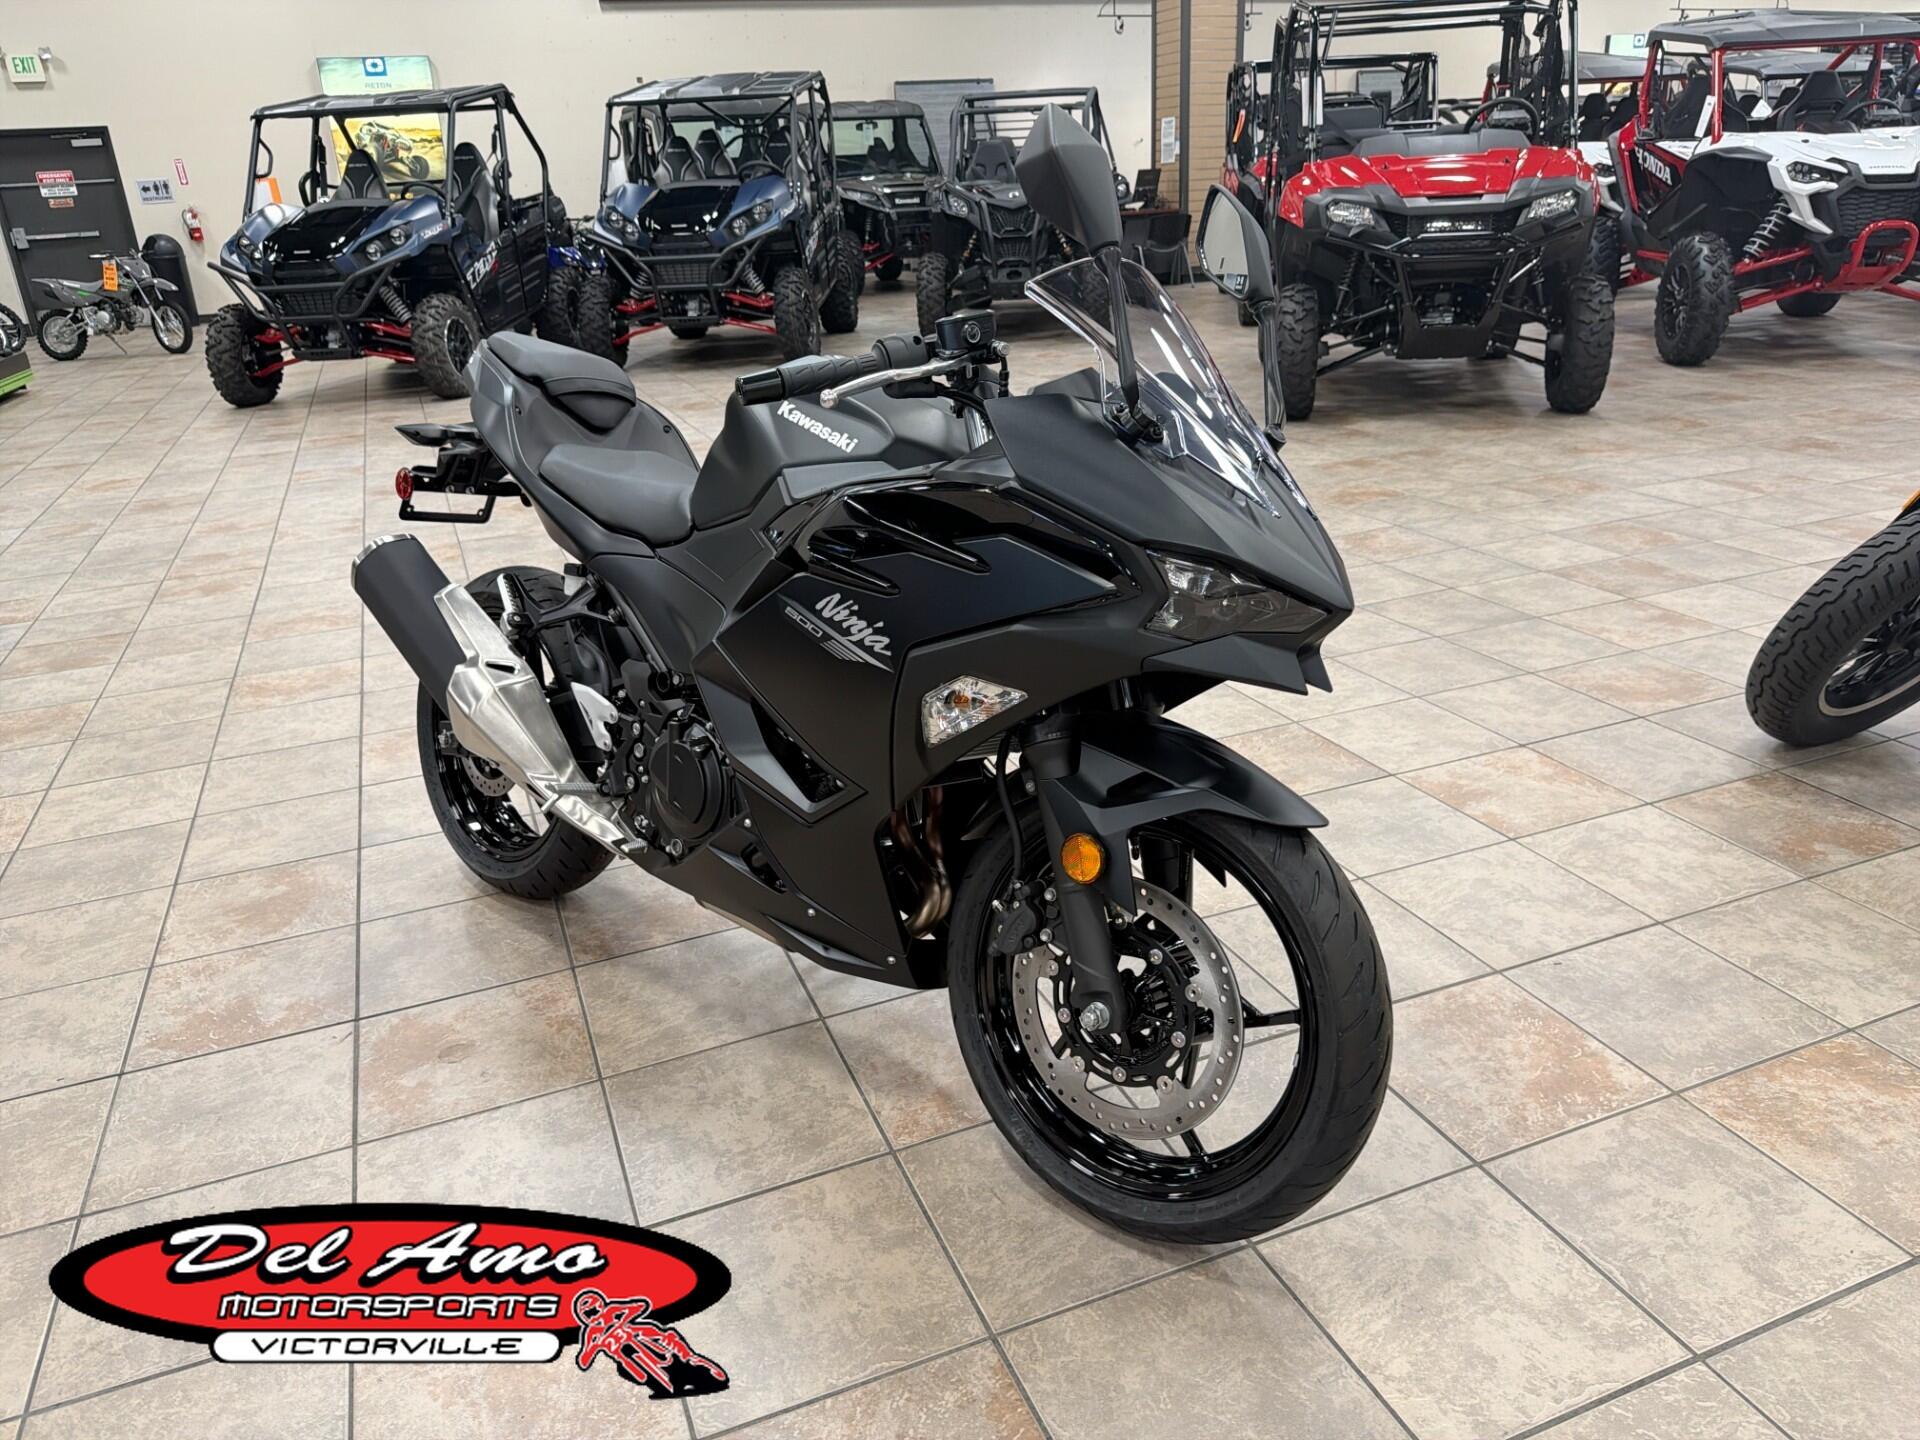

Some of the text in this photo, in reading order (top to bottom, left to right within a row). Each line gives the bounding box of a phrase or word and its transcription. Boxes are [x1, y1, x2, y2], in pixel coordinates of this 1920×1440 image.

[11, 56, 37, 74] EXIT
[776, 400, 859, 454] Kawasaki
[784, 605, 824, 638] 500
[814, 592, 892, 656] Ninja
